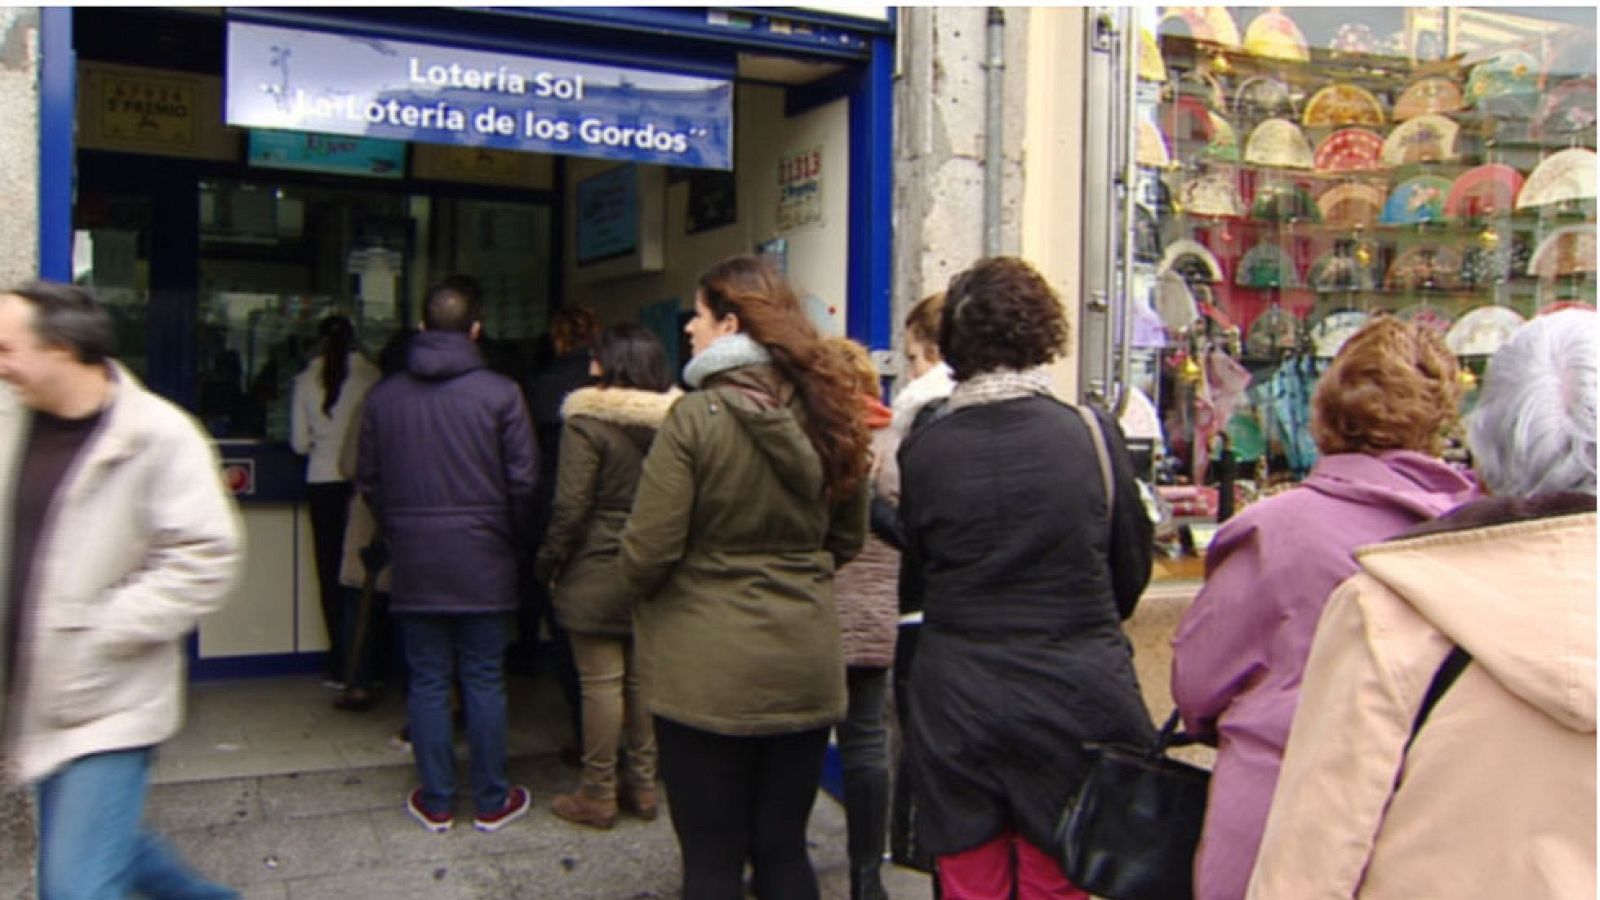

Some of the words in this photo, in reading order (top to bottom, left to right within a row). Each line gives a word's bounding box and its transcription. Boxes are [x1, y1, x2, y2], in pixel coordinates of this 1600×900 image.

[409, 58, 525, 94] Lotería
[535, 69, 584, 100] Sol
[346, 94, 465, 131] Lotería
[475, 107, 514, 136] de
[525, 111, 570, 140] los
